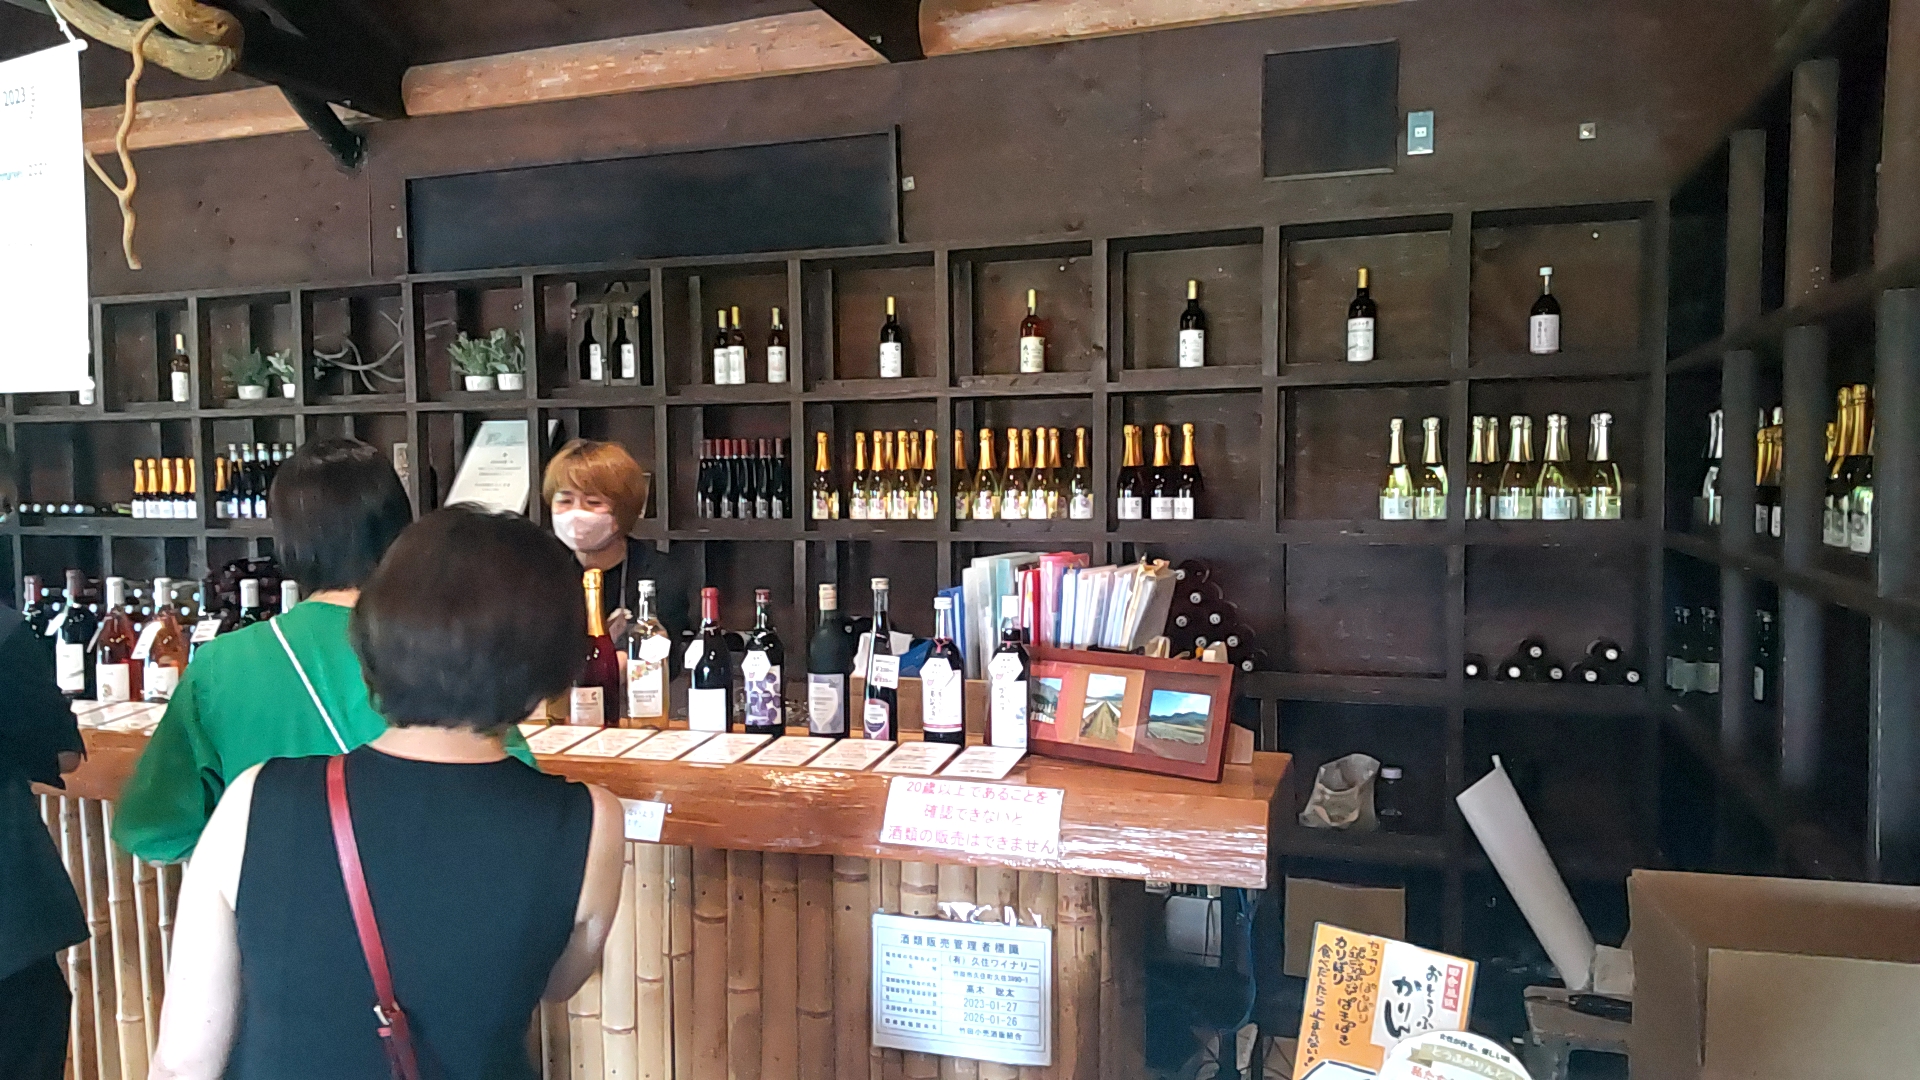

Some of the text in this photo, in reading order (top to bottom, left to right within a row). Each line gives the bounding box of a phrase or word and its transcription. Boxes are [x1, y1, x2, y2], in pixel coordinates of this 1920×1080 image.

[906, 781, 1048, 804] 20歳以上であることを
[924, 804, 1023, 826] 確認できないと
[888, 825, 1055, 854] 酒類の販売はできません
[900, 933, 1020, 955] 酒類販売管理者標識
[963, 997, 1018, 1012] 2023-01-27
[963, 1012, 1018, 1027] 2026-01-26
